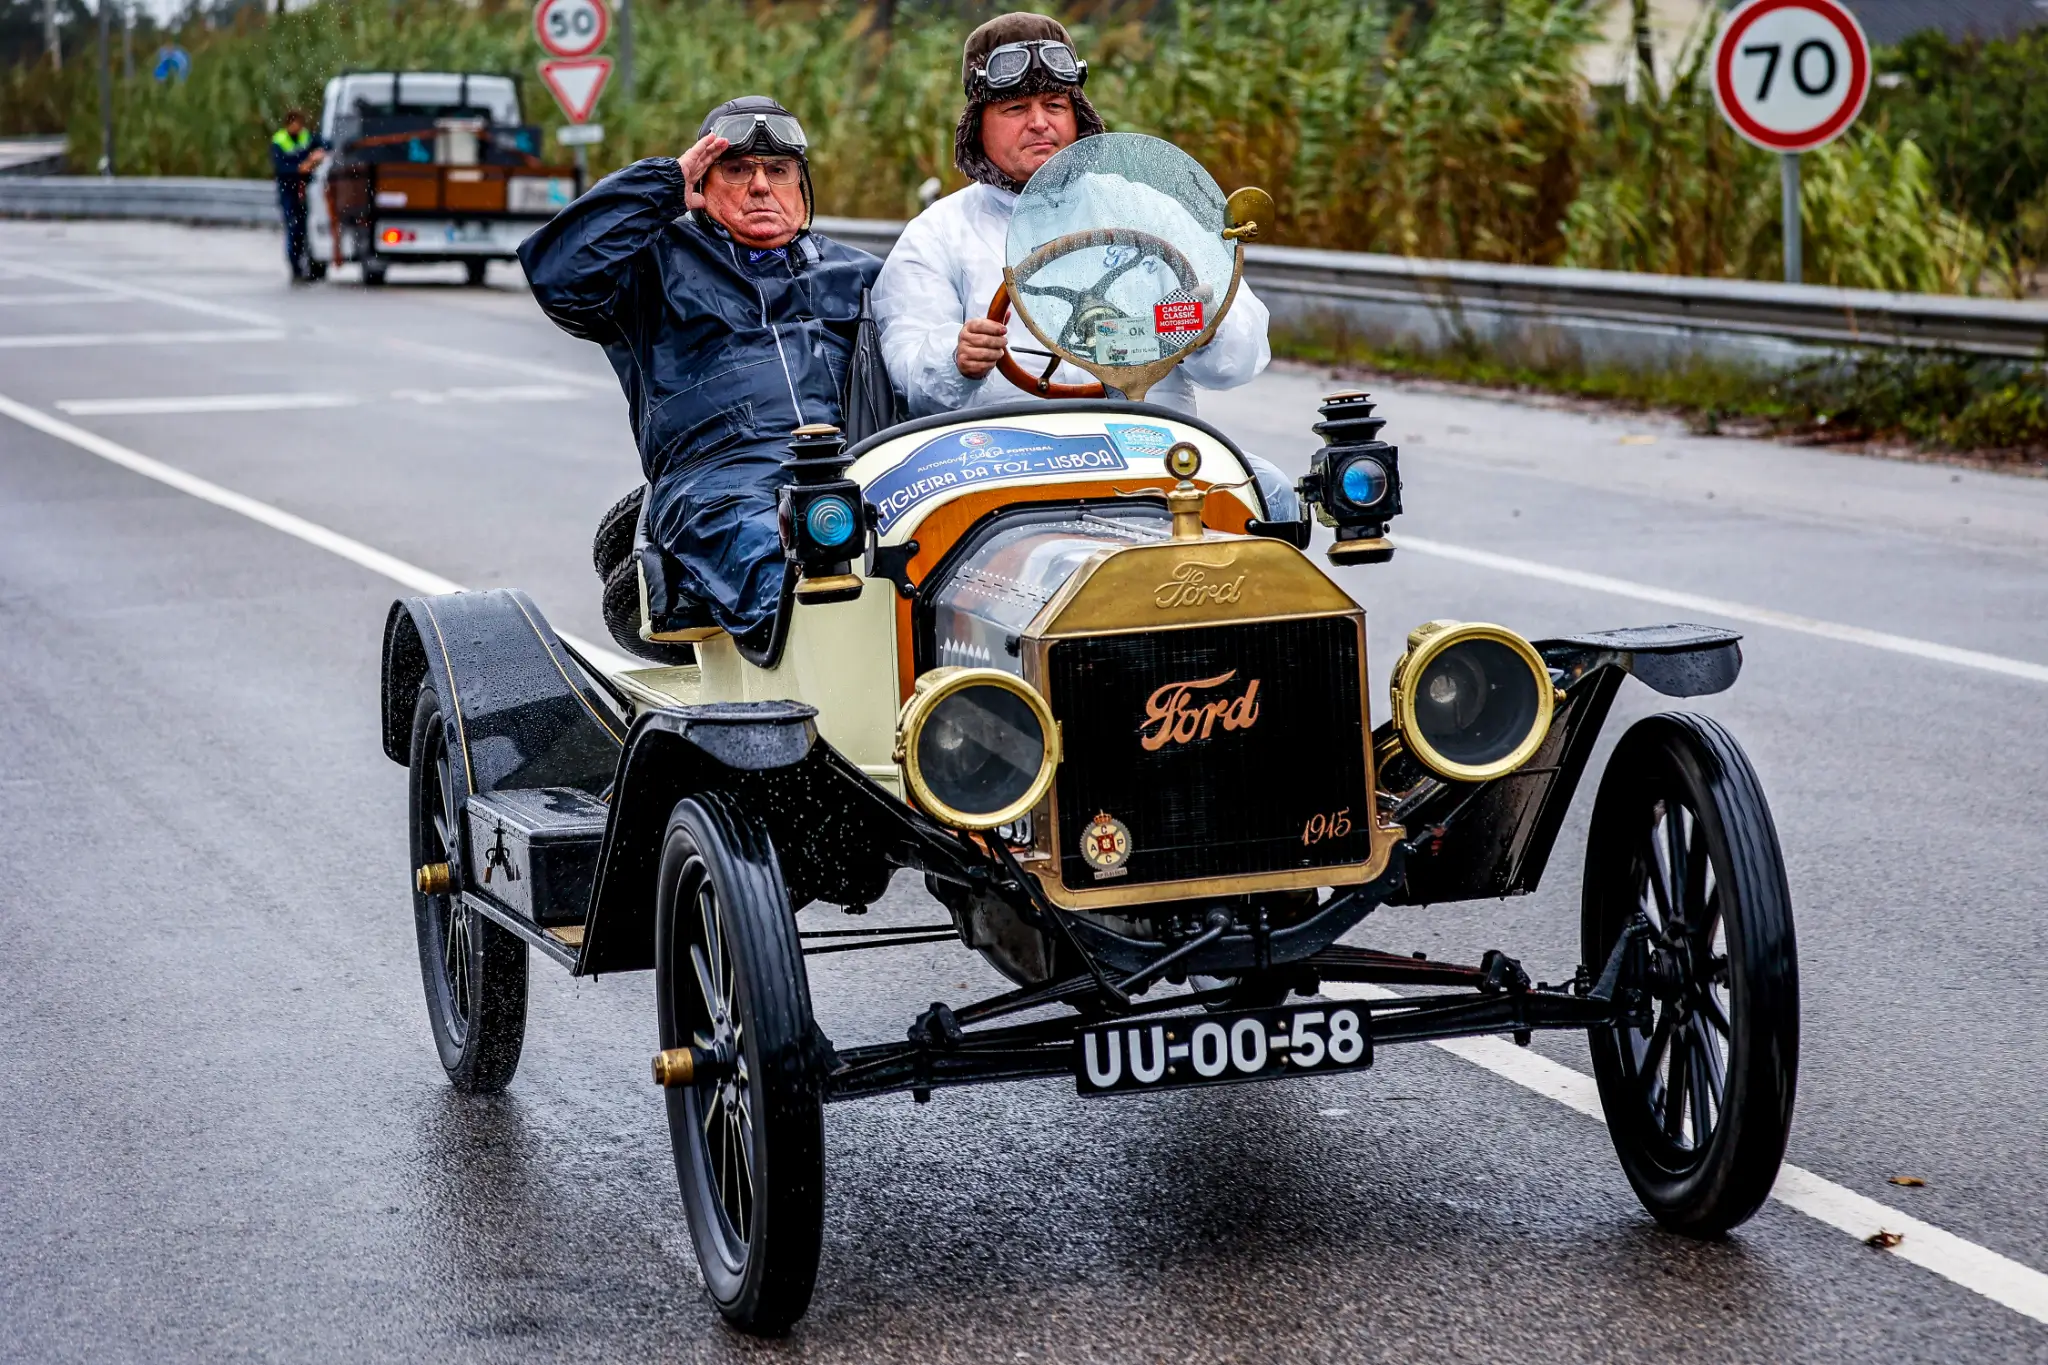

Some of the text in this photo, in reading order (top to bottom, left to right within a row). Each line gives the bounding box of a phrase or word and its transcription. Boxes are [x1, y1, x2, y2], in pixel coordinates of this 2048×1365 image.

[550, 8, 597, 38] 50
[1743, 40, 1837, 103] 70
[1159, 318, 1200, 327] MOTORSHOW
[1162, 304, 1195, 313] CASCAIS
[1163, 311, 1195, 320] CLASSIC
[1129, 327, 1145, 336] OK
[1006, 445, 1053, 454] PORTUGAL
[879, 472, 958, 520] FIGUEIRA
[960, 466, 989, 480] DA
[993, 460, 1032, 475] FOZ
[1046, 449, 1114, 469] LISBOA
[1153, 558, 1245, 608] Ford
[1140, 669, 1261, 751] Ford
[1301, 807, 1351, 845] 1915
[1084, 1009, 1364, 1088] UU-00-58
